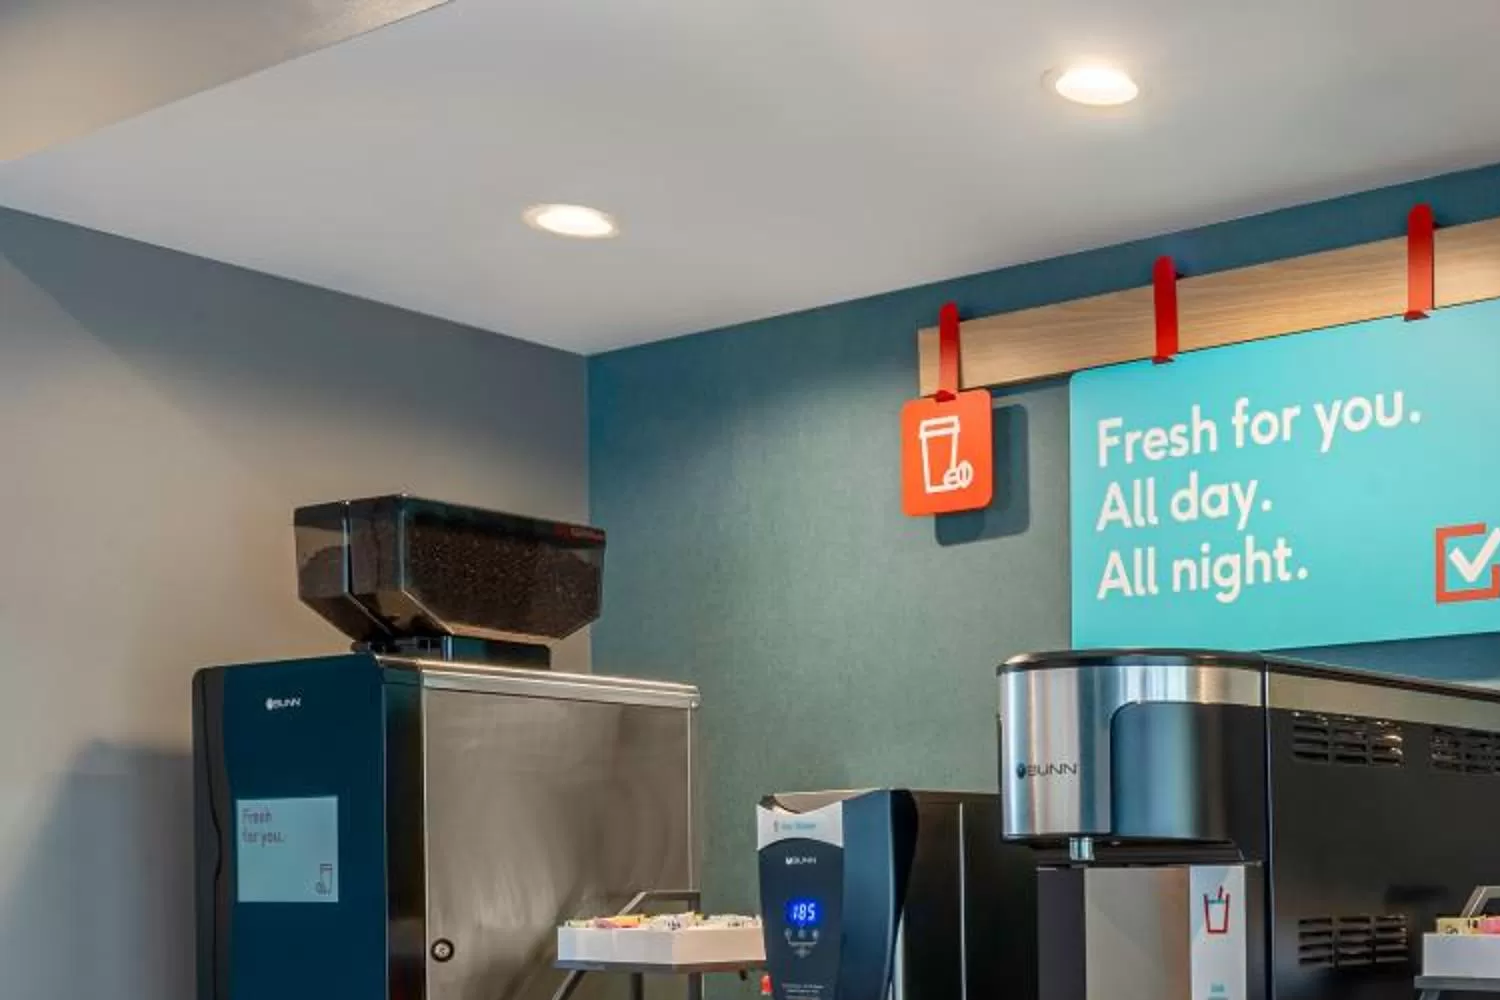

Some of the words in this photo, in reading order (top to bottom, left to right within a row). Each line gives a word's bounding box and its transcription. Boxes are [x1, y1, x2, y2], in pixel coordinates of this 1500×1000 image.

[1098, 404, 1217, 467] Fresh
[1231, 397, 1301, 448] for
[1313, 390, 1421, 453] you.
[1096, 476, 1159, 532] All
[1170, 469, 1273, 531] day.
[1096, 545, 1159, 600] All
[1171, 535, 1308, 603] night.
[1027, 762, 1077, 777] BUNN
[793, 903, 816, 921] 185
